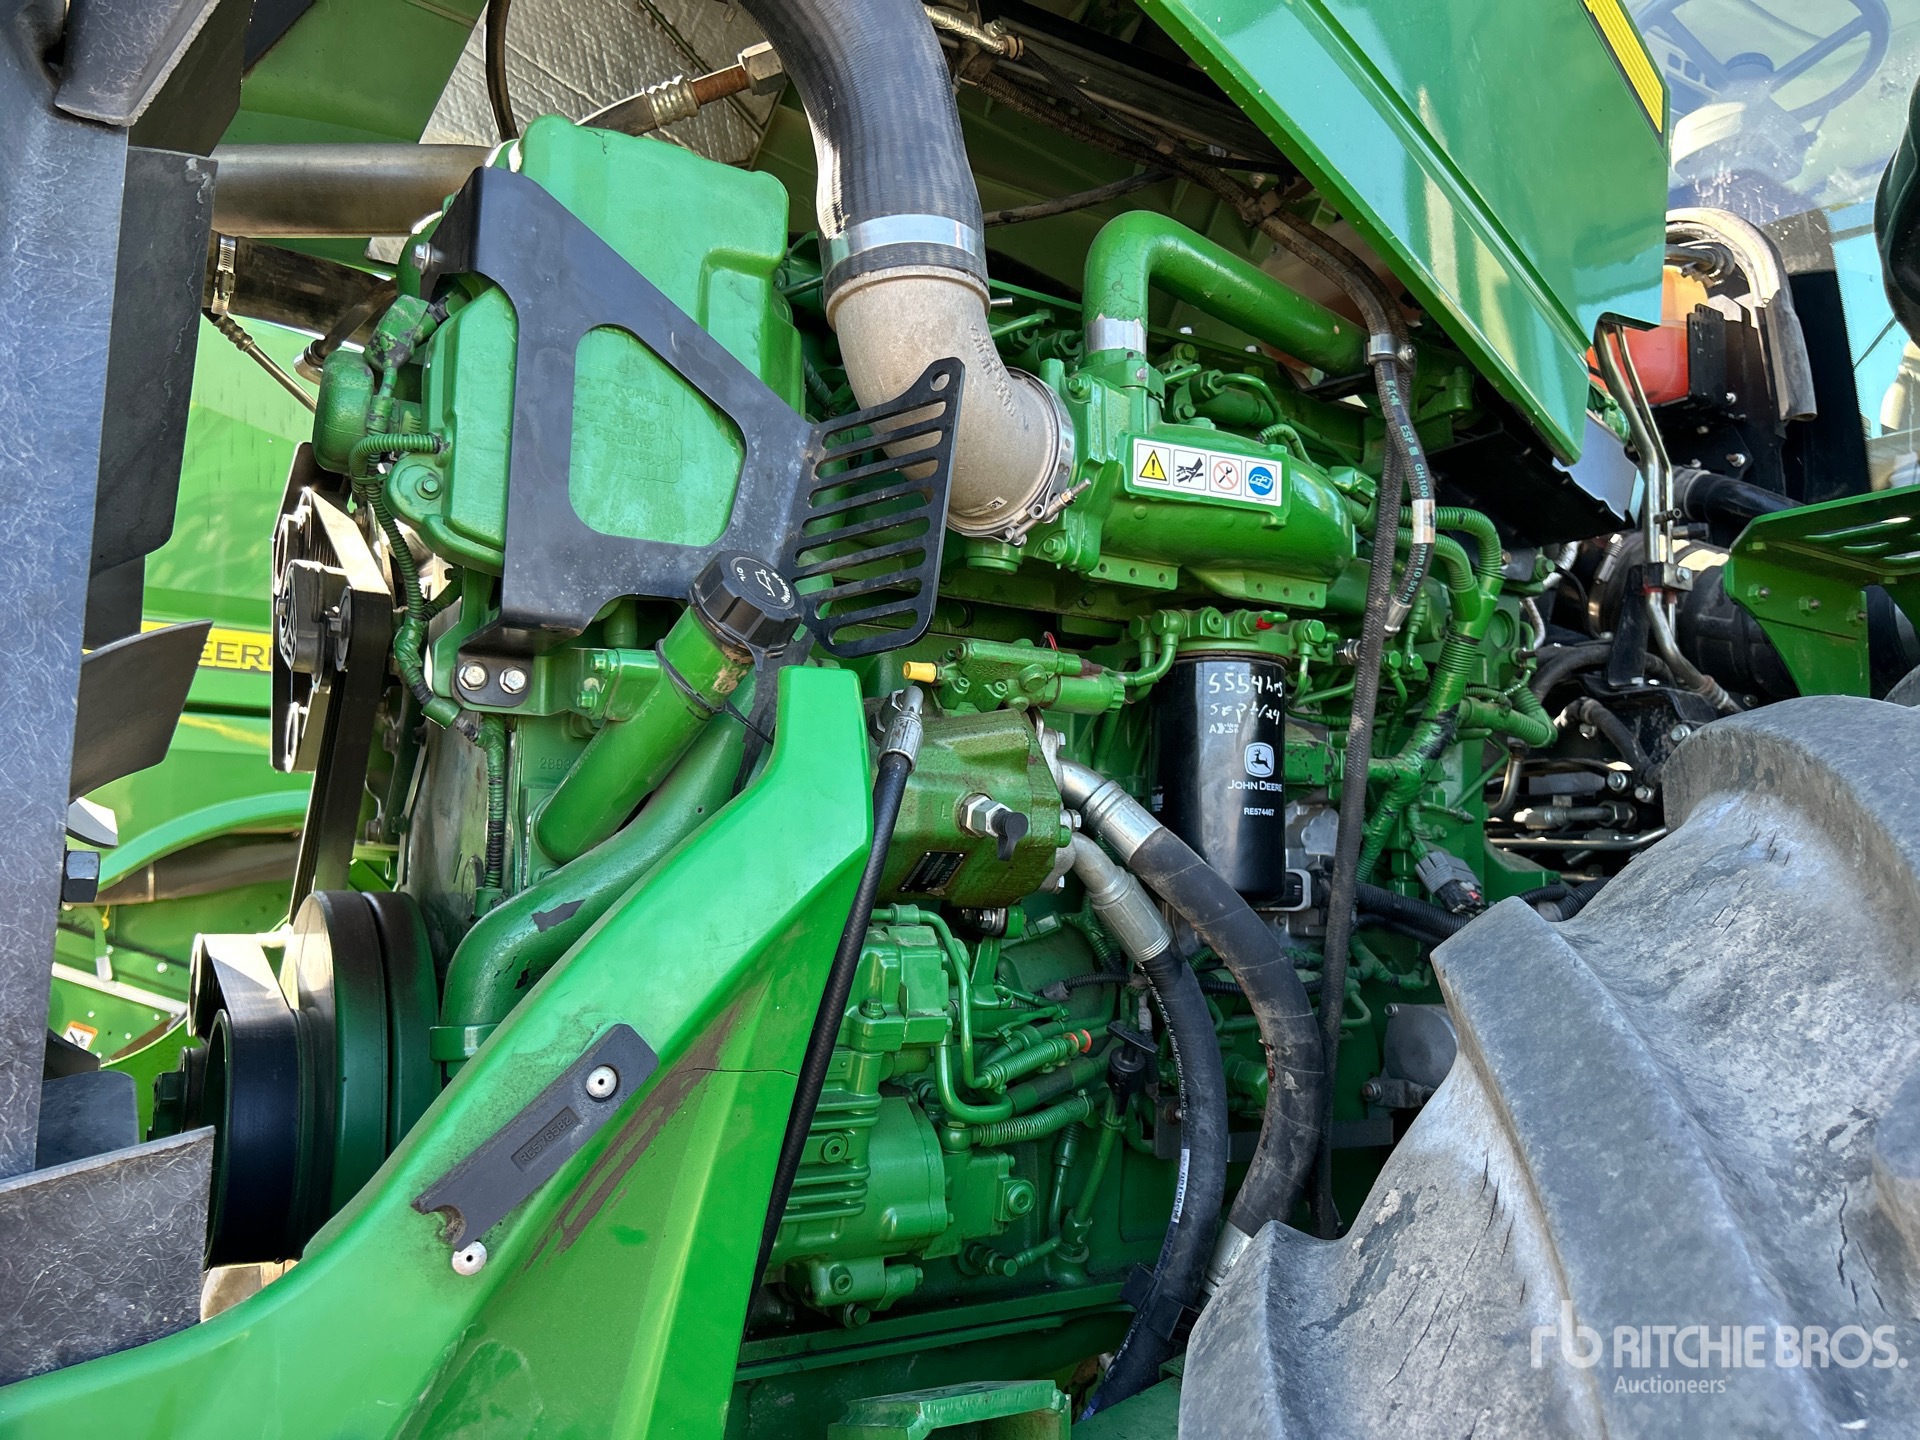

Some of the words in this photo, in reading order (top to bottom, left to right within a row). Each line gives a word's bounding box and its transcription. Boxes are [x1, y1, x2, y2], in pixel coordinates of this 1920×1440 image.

[1400, 424, 1415, 443] ESP
[736, 566, 747, 582] OIL
[1227, 779, 1258, 791] JOHN
[1259, 780, 1283, 792] DEERE
[519, 1115, 572, 1164] RE576582
